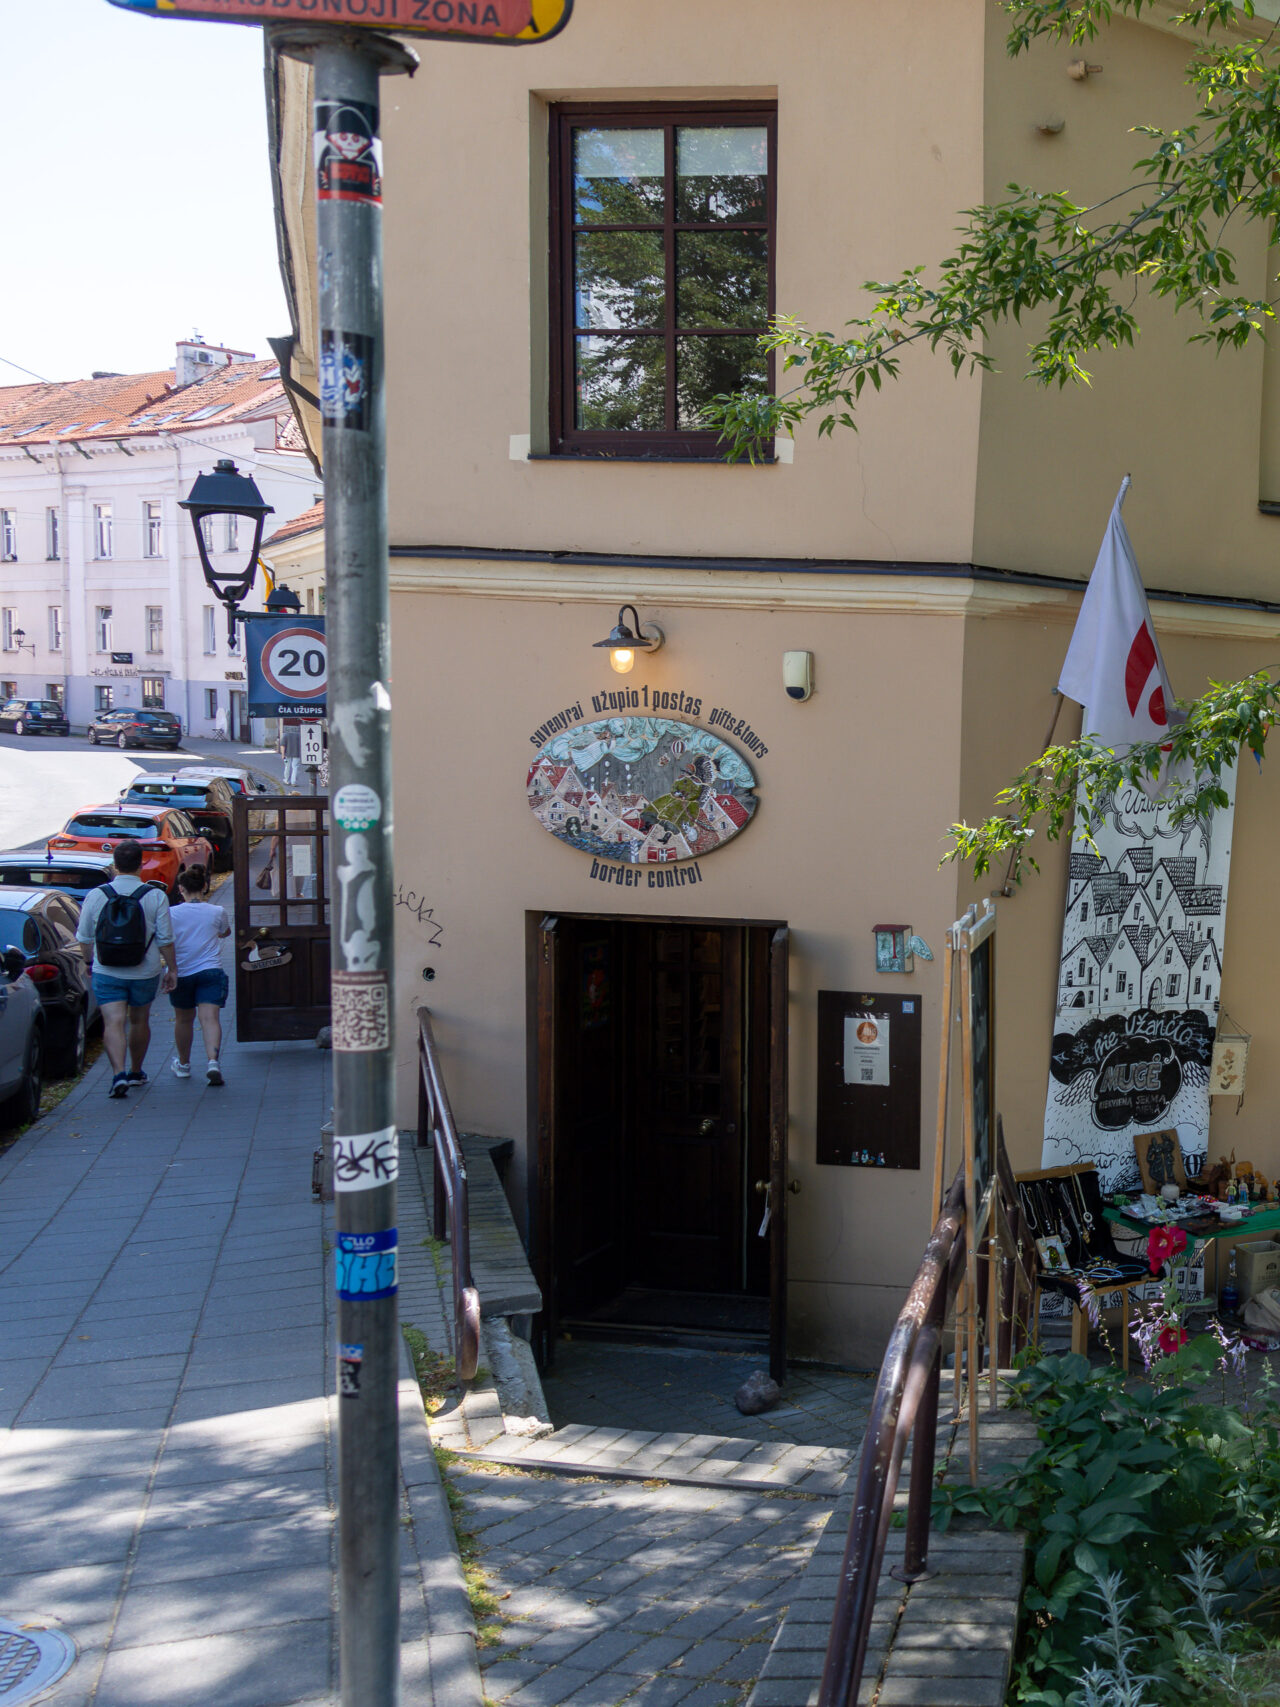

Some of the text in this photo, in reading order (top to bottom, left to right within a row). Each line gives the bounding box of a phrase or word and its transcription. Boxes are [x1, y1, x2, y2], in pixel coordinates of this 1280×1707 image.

[412, 0, 500, 27] ZONA
[278, 650, 325, 678] 20
[278, 705, 323, 714] ČIA UŽUPIS
[530, 685, 769, 760] suvenyrai užupio 1 postas gifts&tours
[305, 742, 319, 752] 10
[306, 754, 317, 762] m
[590, 859, 702, 888] border control
[251, 957, 282, 969] WELCOME
